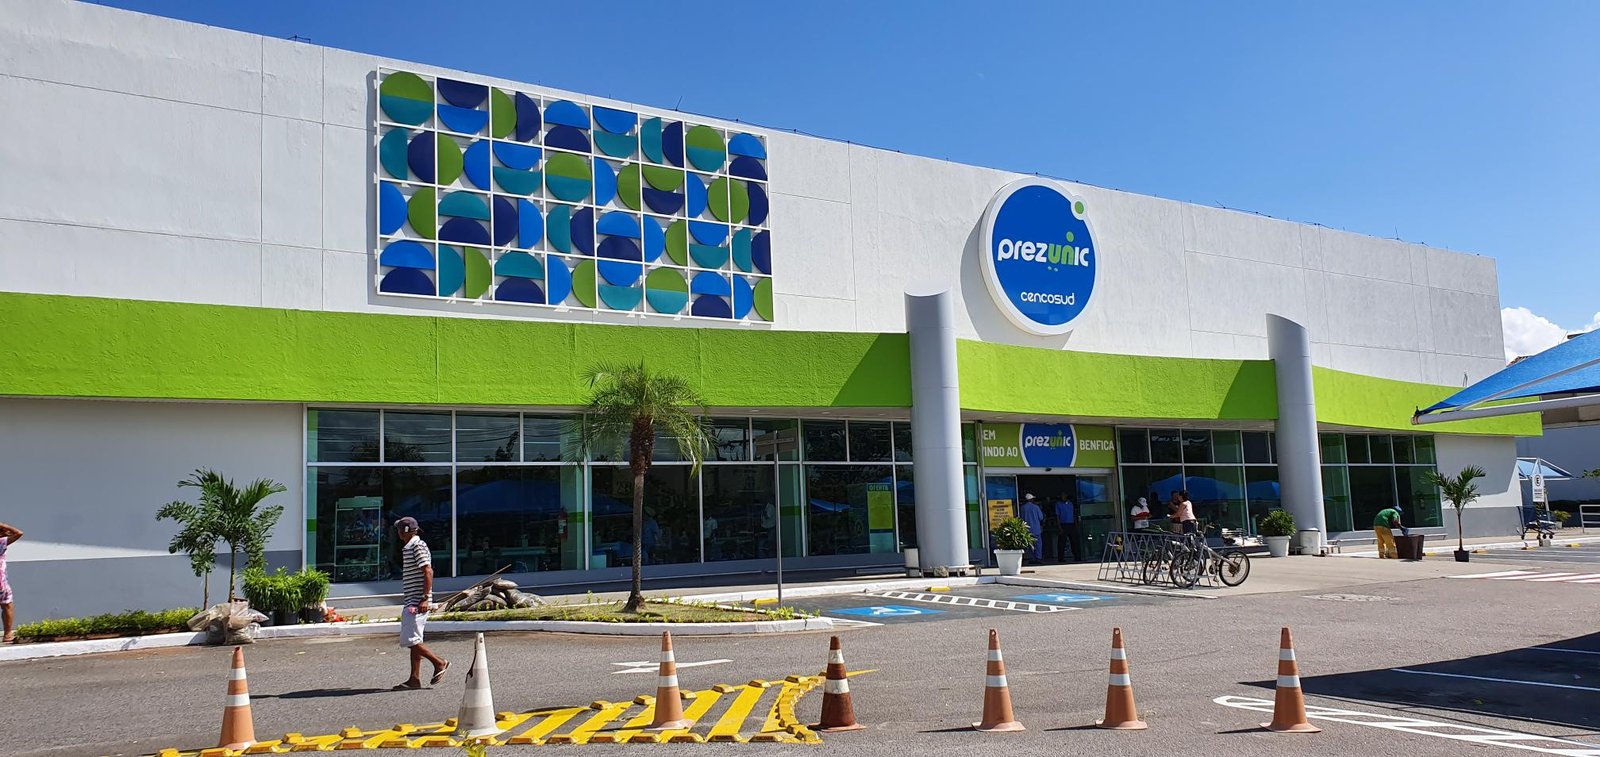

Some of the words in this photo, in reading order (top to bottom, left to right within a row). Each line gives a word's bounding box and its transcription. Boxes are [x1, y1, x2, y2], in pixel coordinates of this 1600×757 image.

[998, 232, 1090, 267] prezunic
[1020, 291, 1075, 306] cencosud
[983, 430, 996, 440] EM
[1025, 430, 1072, 448] prezunic
[1006, 446, 1018, 457] AO
[1079, 440, 1115, 452] BENFICA
